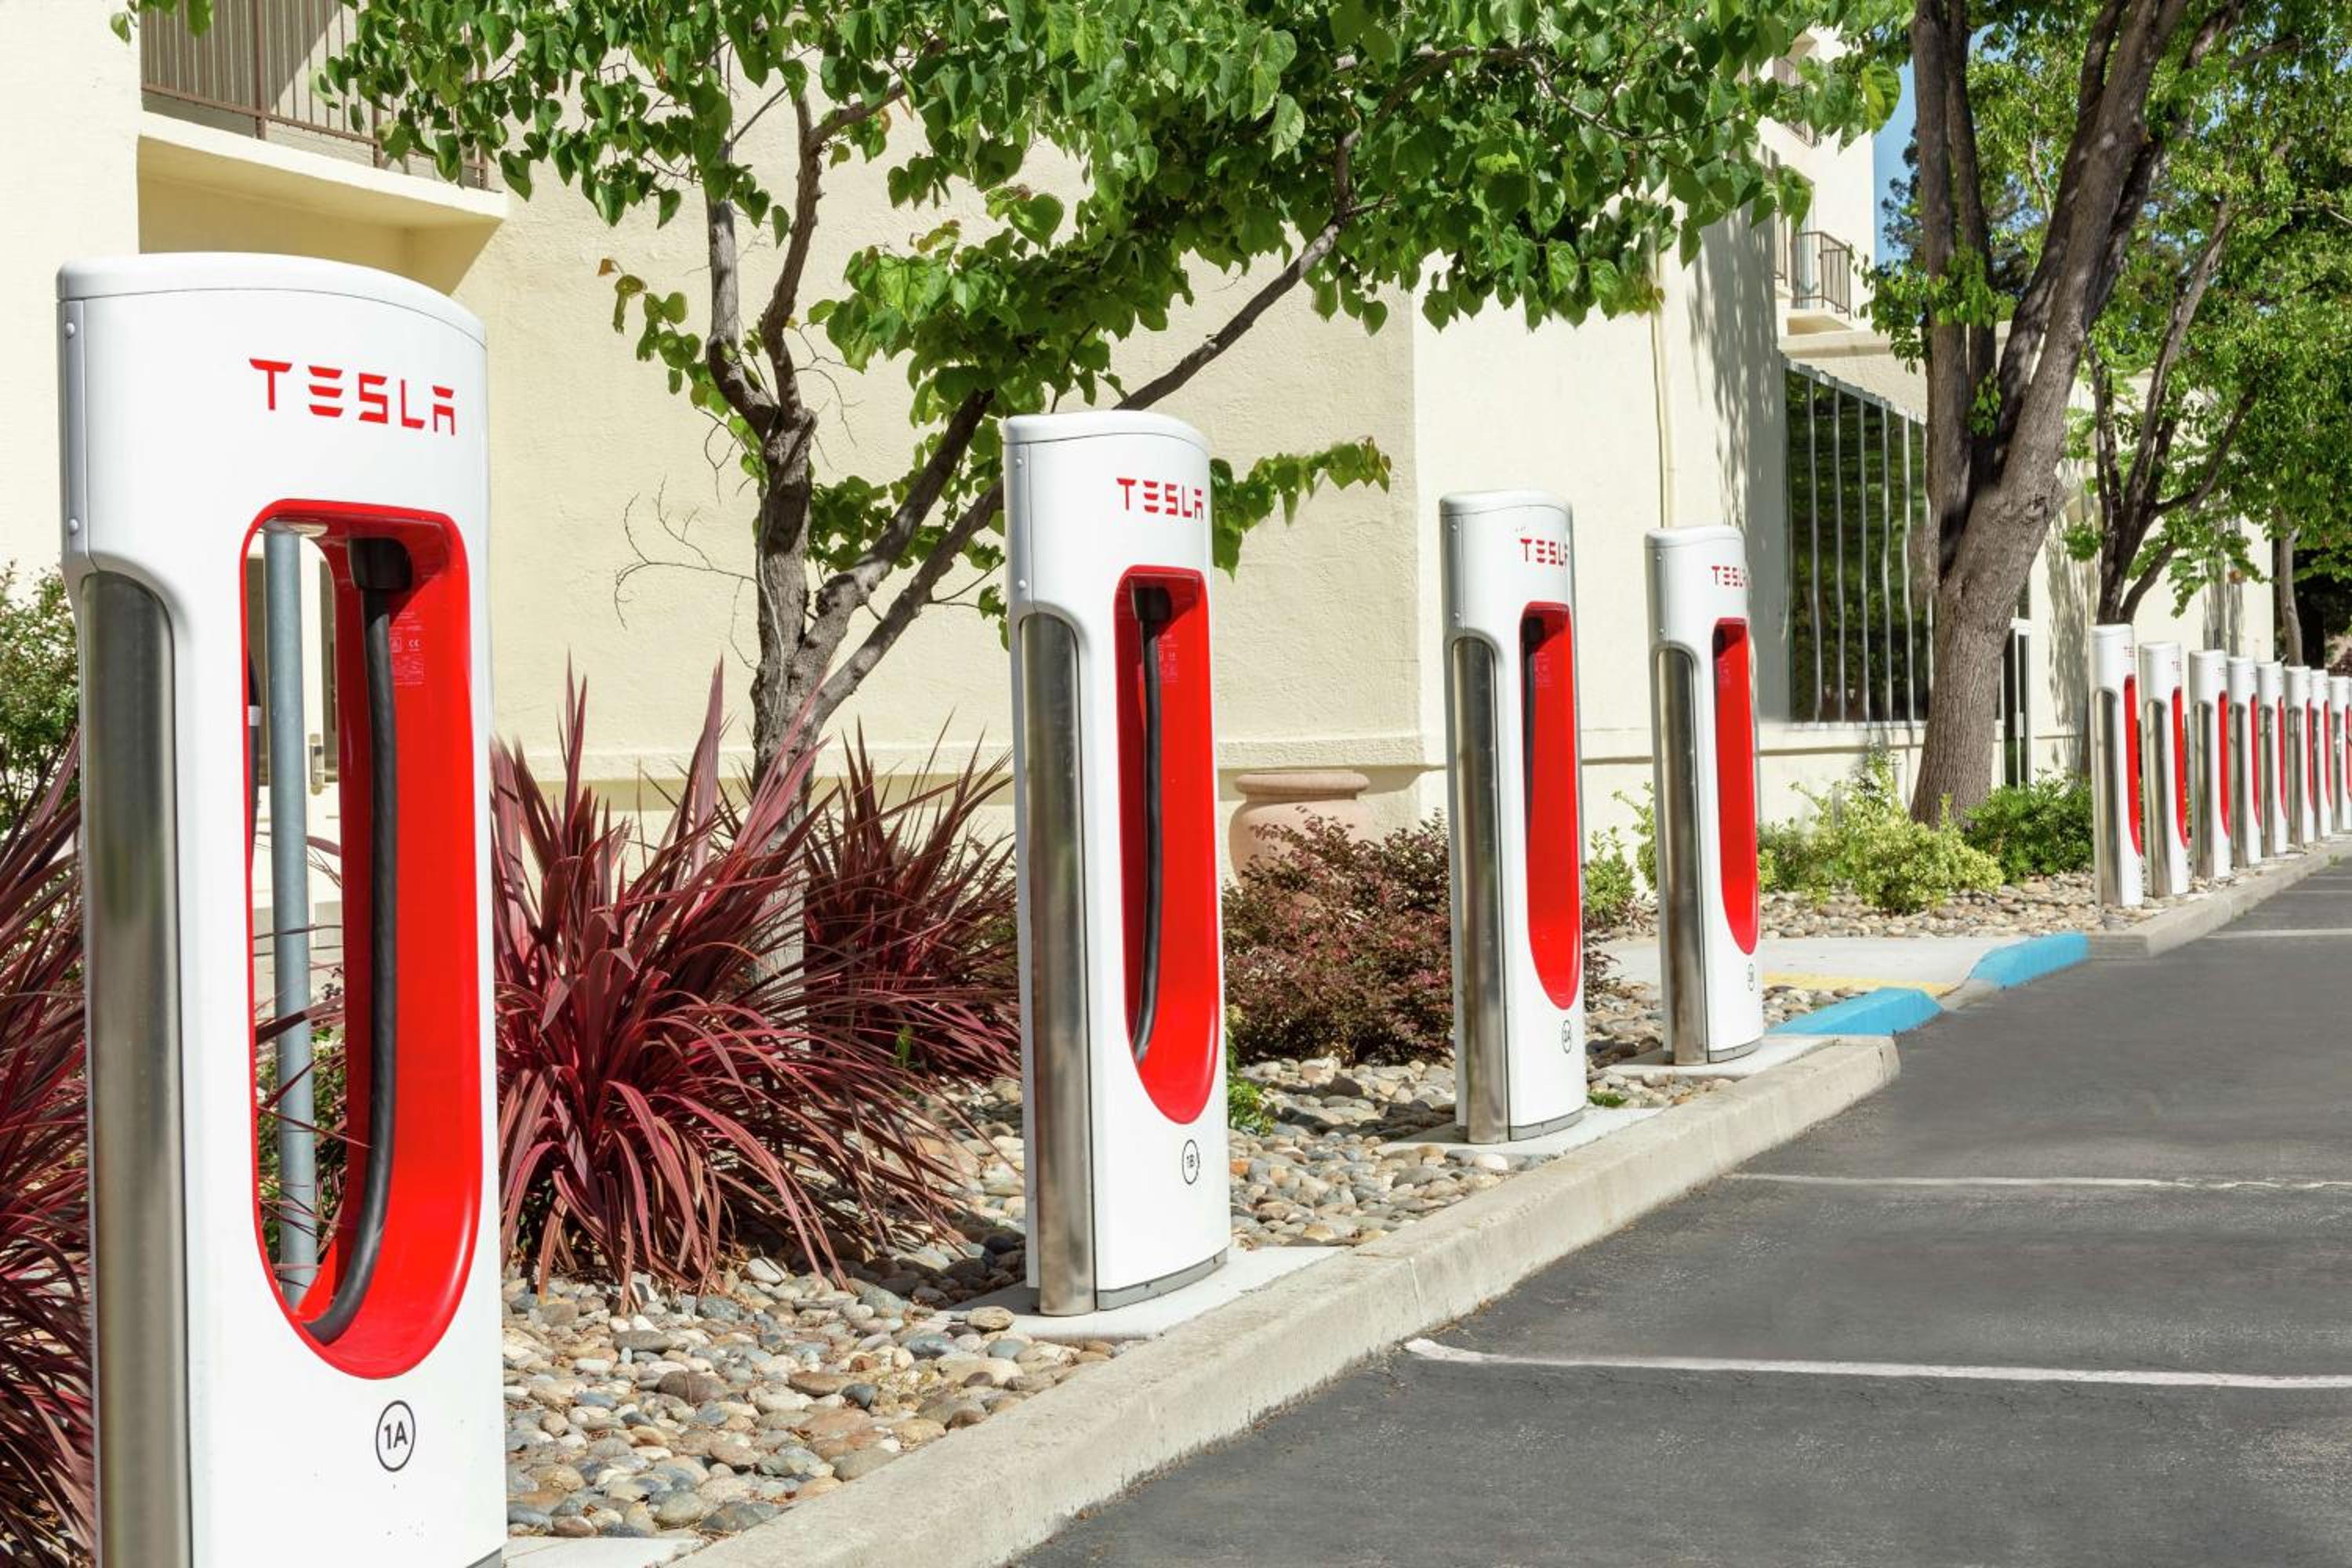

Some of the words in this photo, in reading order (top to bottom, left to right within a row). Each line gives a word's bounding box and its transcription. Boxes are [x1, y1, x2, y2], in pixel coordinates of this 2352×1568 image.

[249, 358, 455, 436] TESLA
[1116, 477, 1203, 521] TESLA
[384, 1421, 408, 1449] 1A
